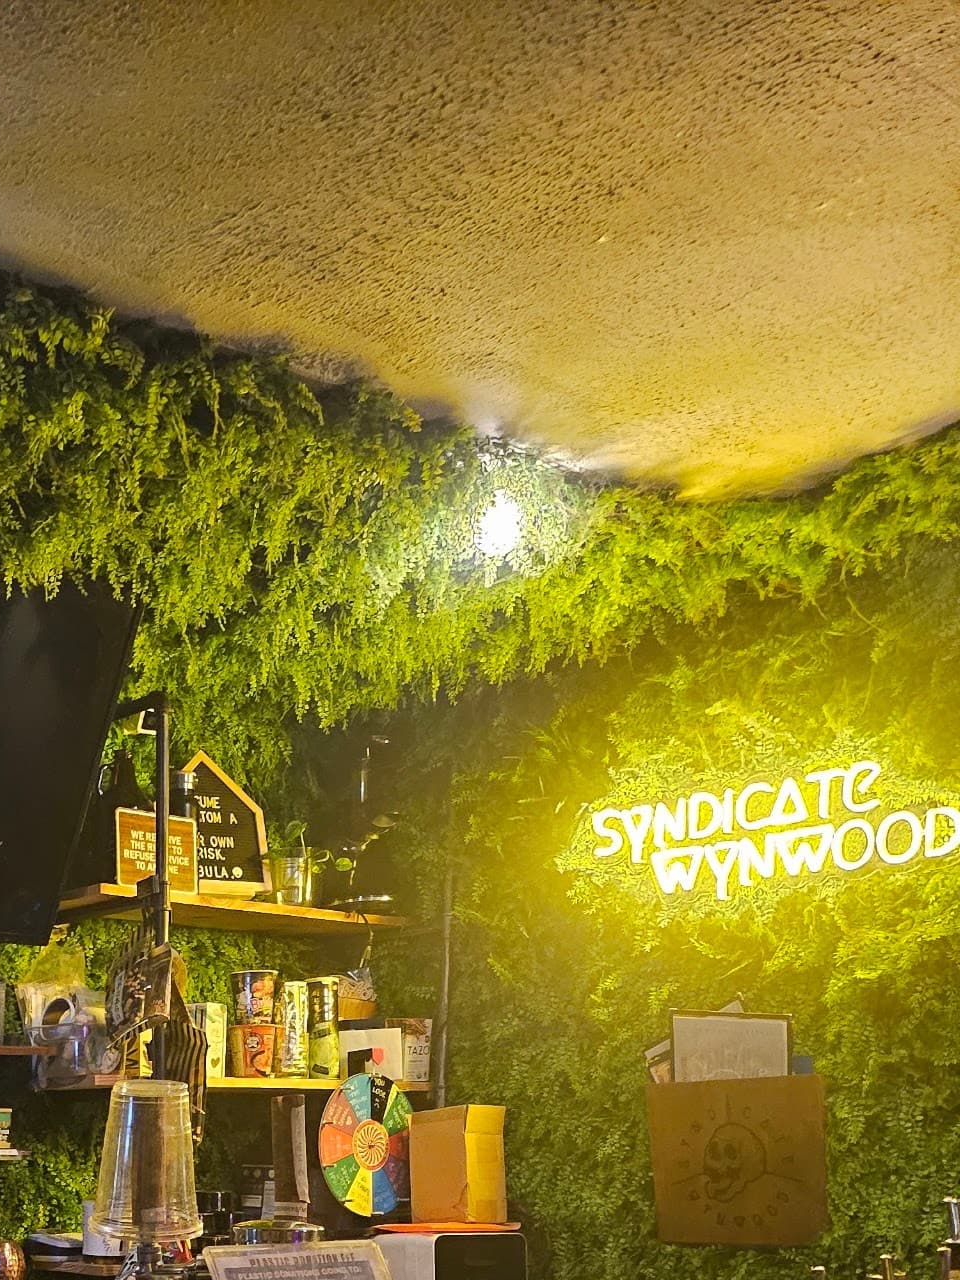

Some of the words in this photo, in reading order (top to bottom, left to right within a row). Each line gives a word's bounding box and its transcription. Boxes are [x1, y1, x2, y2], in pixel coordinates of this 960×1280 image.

[199, 810, 222, 824] TOM
[592, 760, 883, 864] SYNDICATE
[130, 829, 145, 841] WE
[209, 835, 235, 849] OWN
[130, 839, 147, 851] THE
[171, 845, 183, 856] TO
[650, 806, 960, 901] WYNWOOD
[123, 848, 156, 862] REFUSE
[135, 860, 146, 871] TO
[407, 1044, 430, 1056] TAZO
[238, 1271, 273, 1280] PLASTIC
